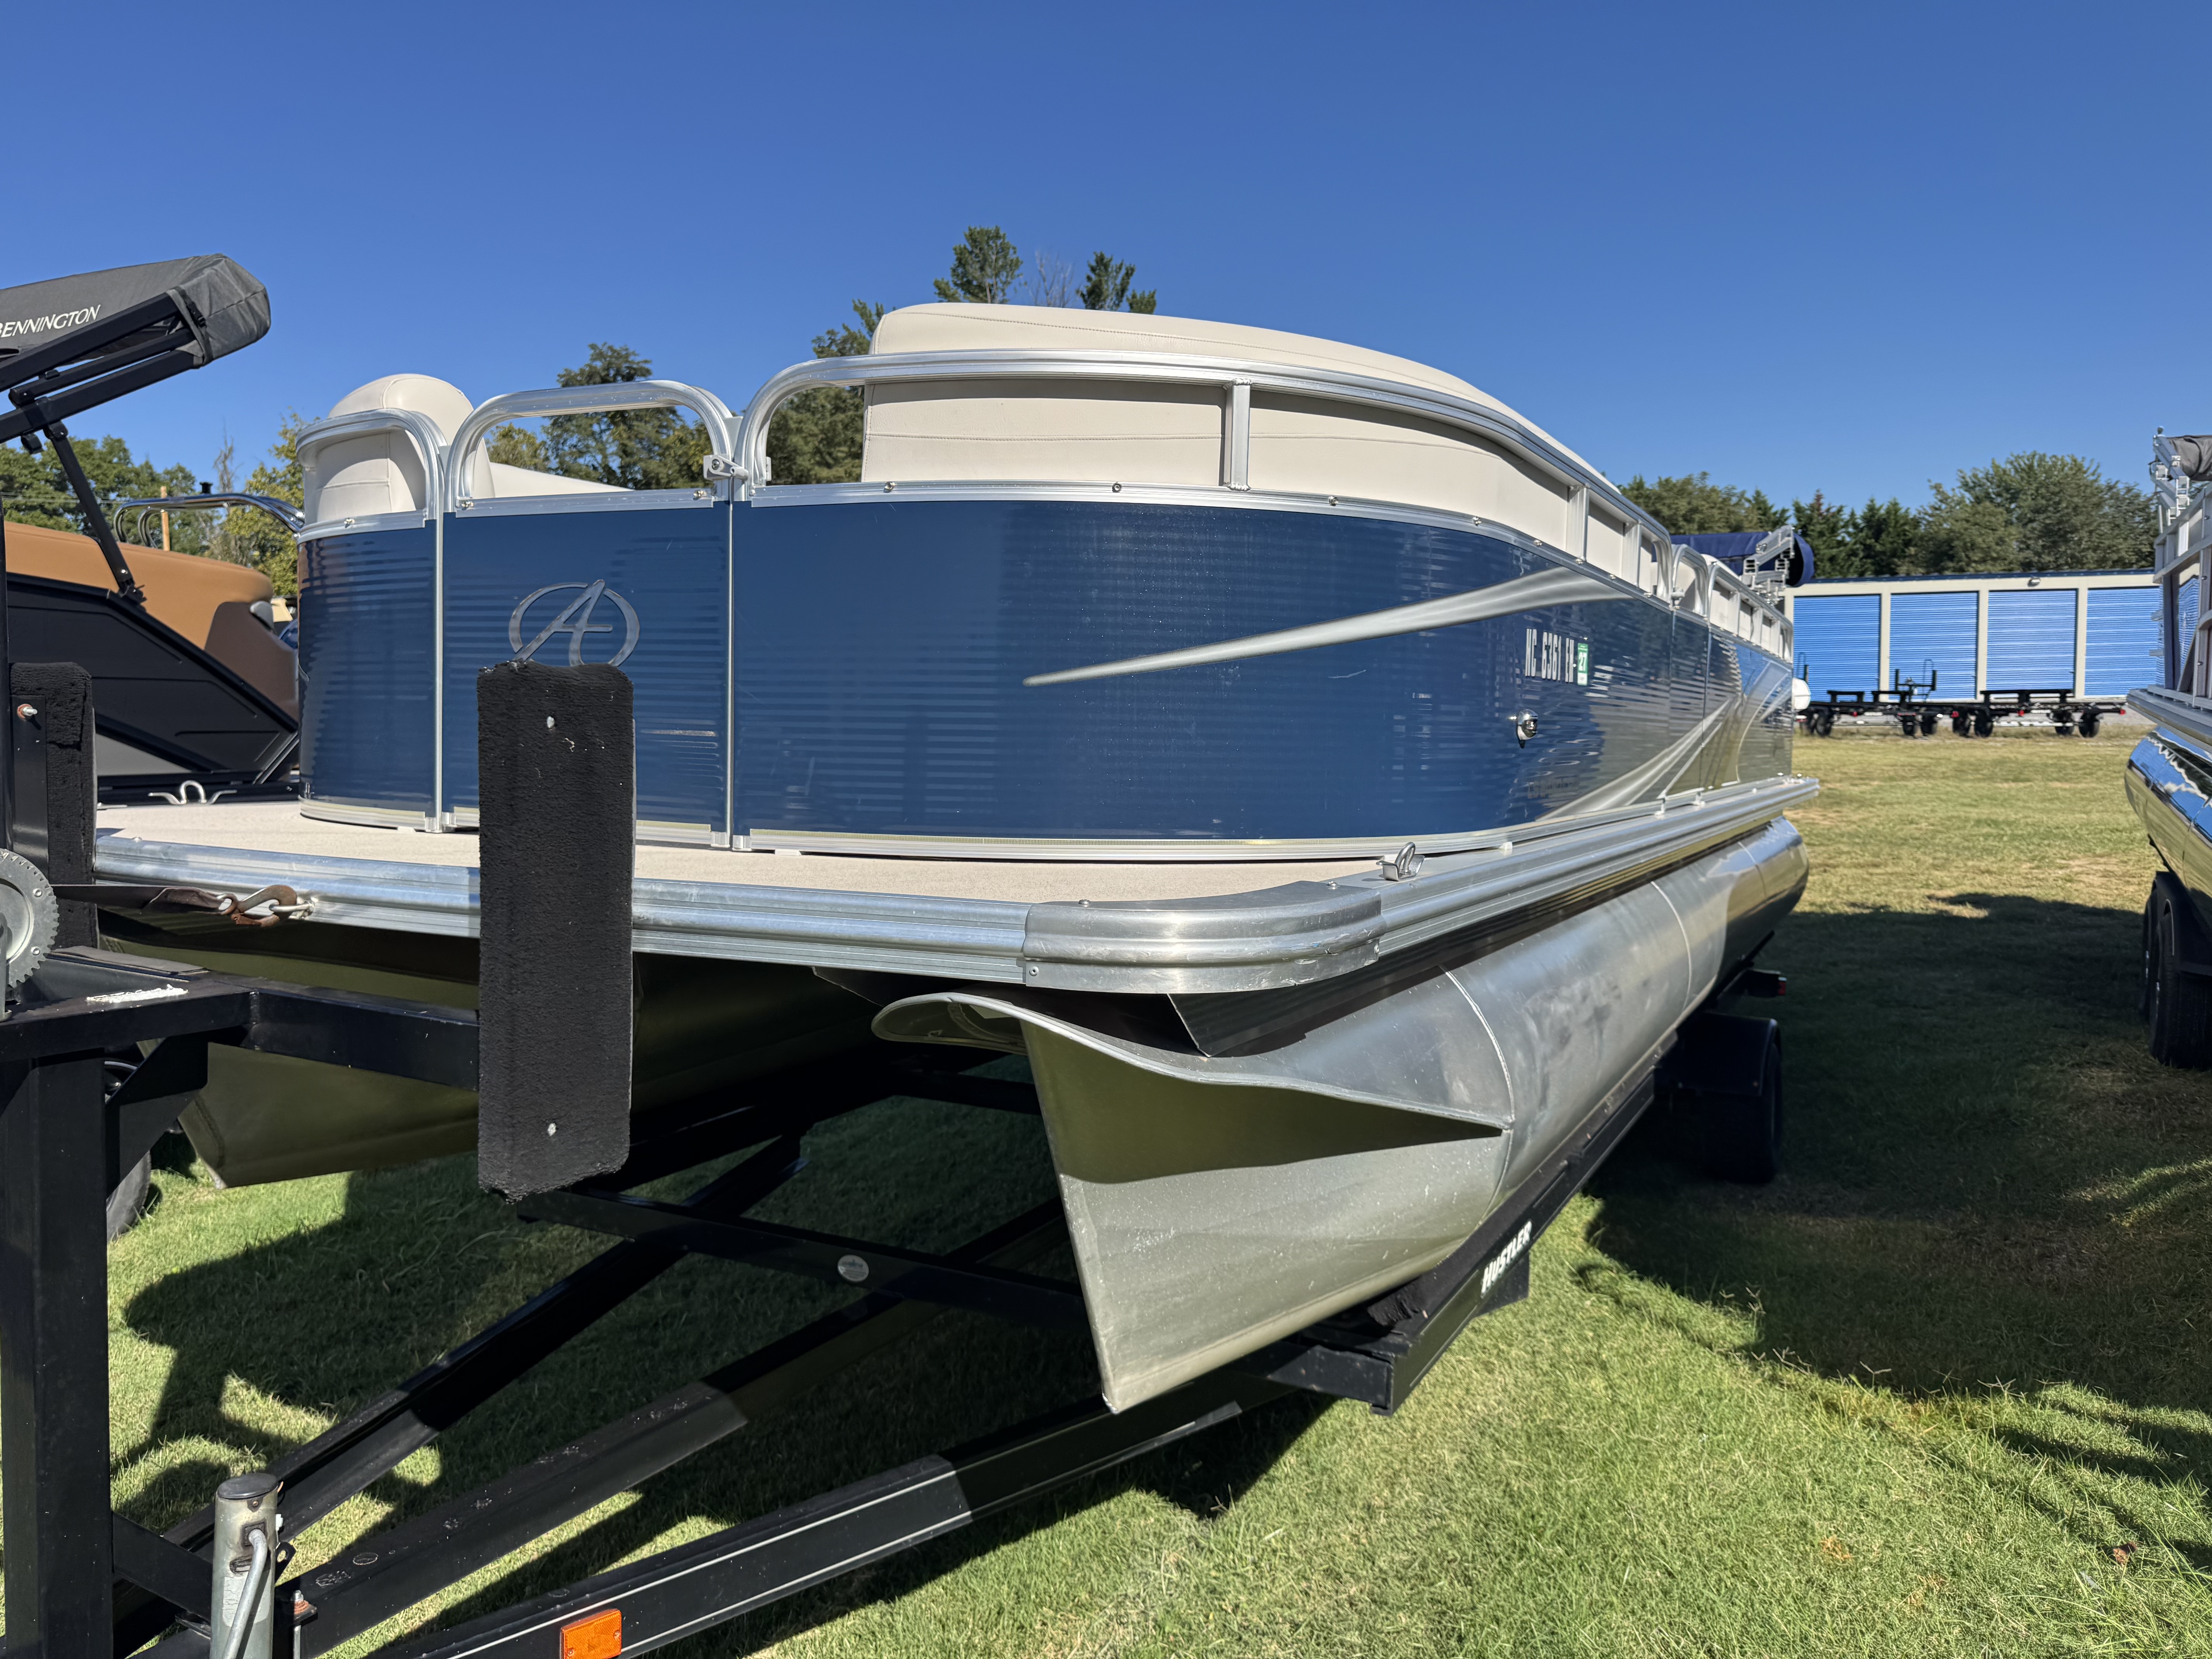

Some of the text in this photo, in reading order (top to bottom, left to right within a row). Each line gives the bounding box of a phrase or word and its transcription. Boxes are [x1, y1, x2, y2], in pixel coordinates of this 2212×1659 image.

[1525, 629, 1537, 677] NC
[1542, 632, 1561, 681] 6361
[1578, 652, 1587, 671] 27
[1481, 1221, 1532, 1294] HUSTLER
